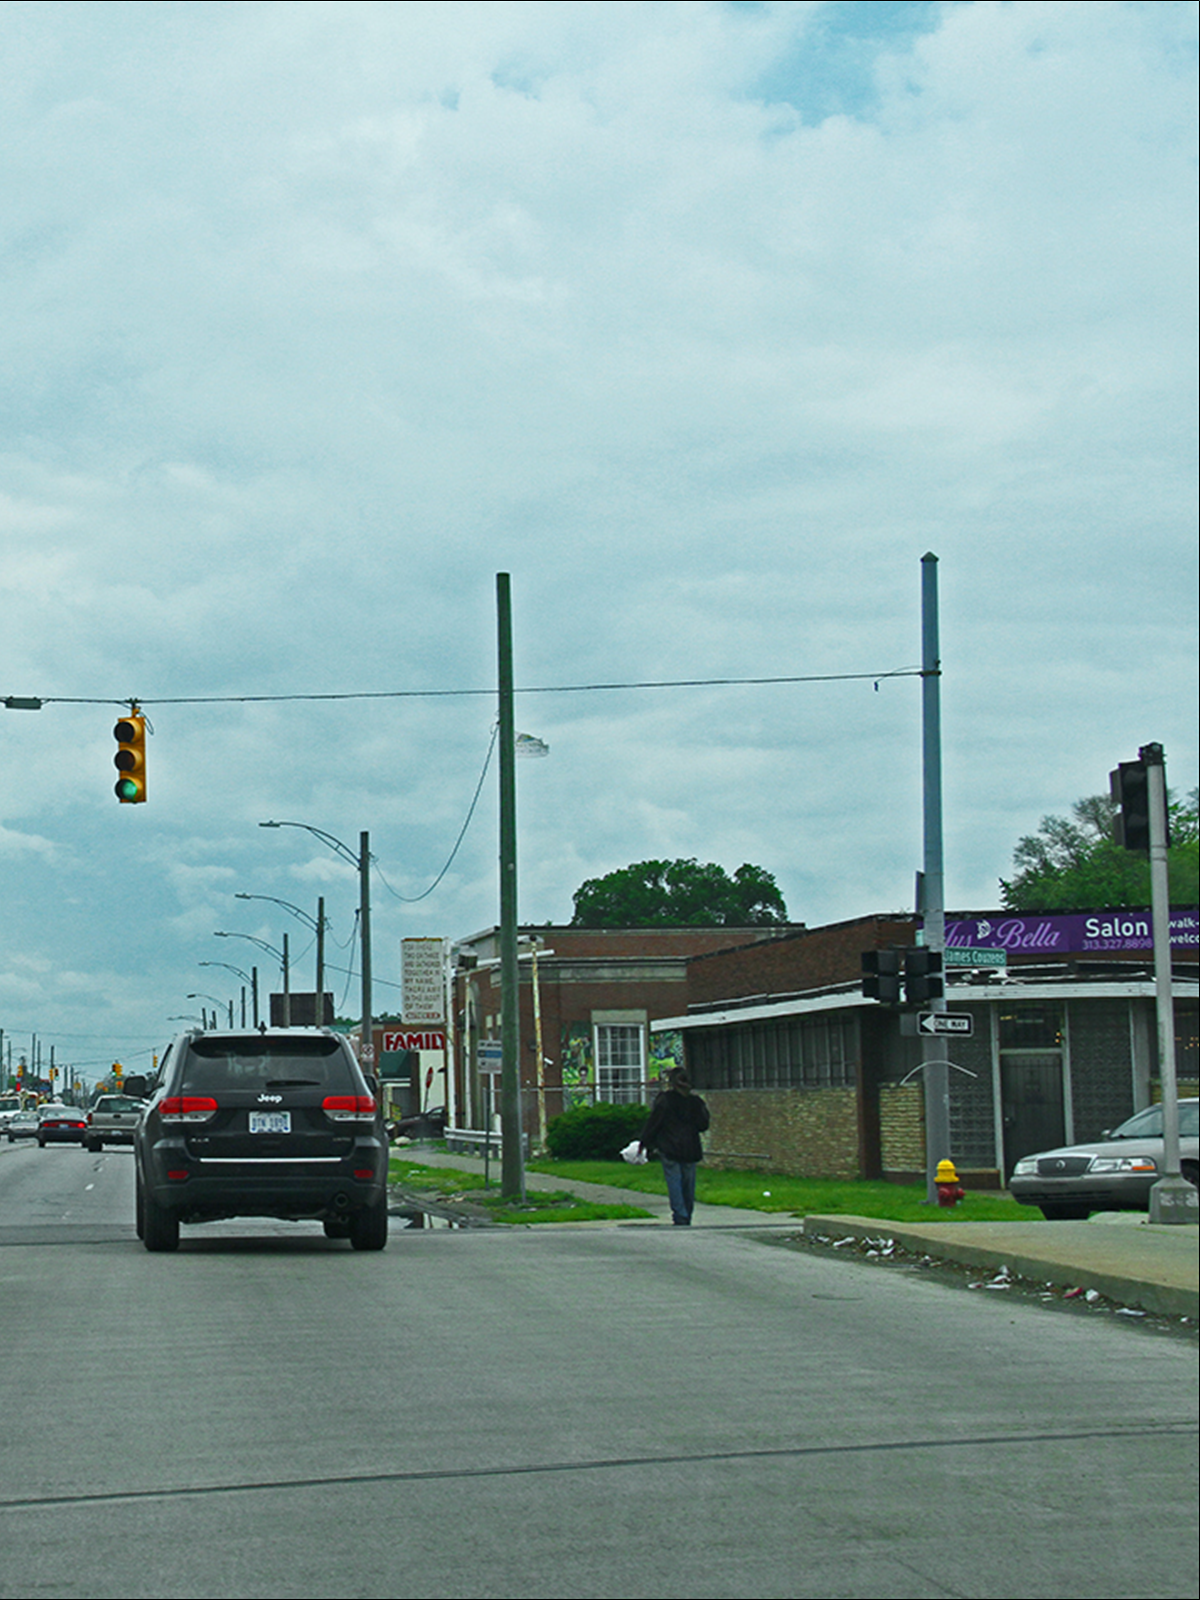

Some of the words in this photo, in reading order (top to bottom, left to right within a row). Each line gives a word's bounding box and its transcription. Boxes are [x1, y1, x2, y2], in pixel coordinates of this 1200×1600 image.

[991, 919, 1060, 948] Bella
[1085, 918, 1148, 937] Salon
[934, 1019, 947, 1028] ONE
[951, 1020, 966, 1028] WAY
[257, 1093, 282, 1104] Jeep
